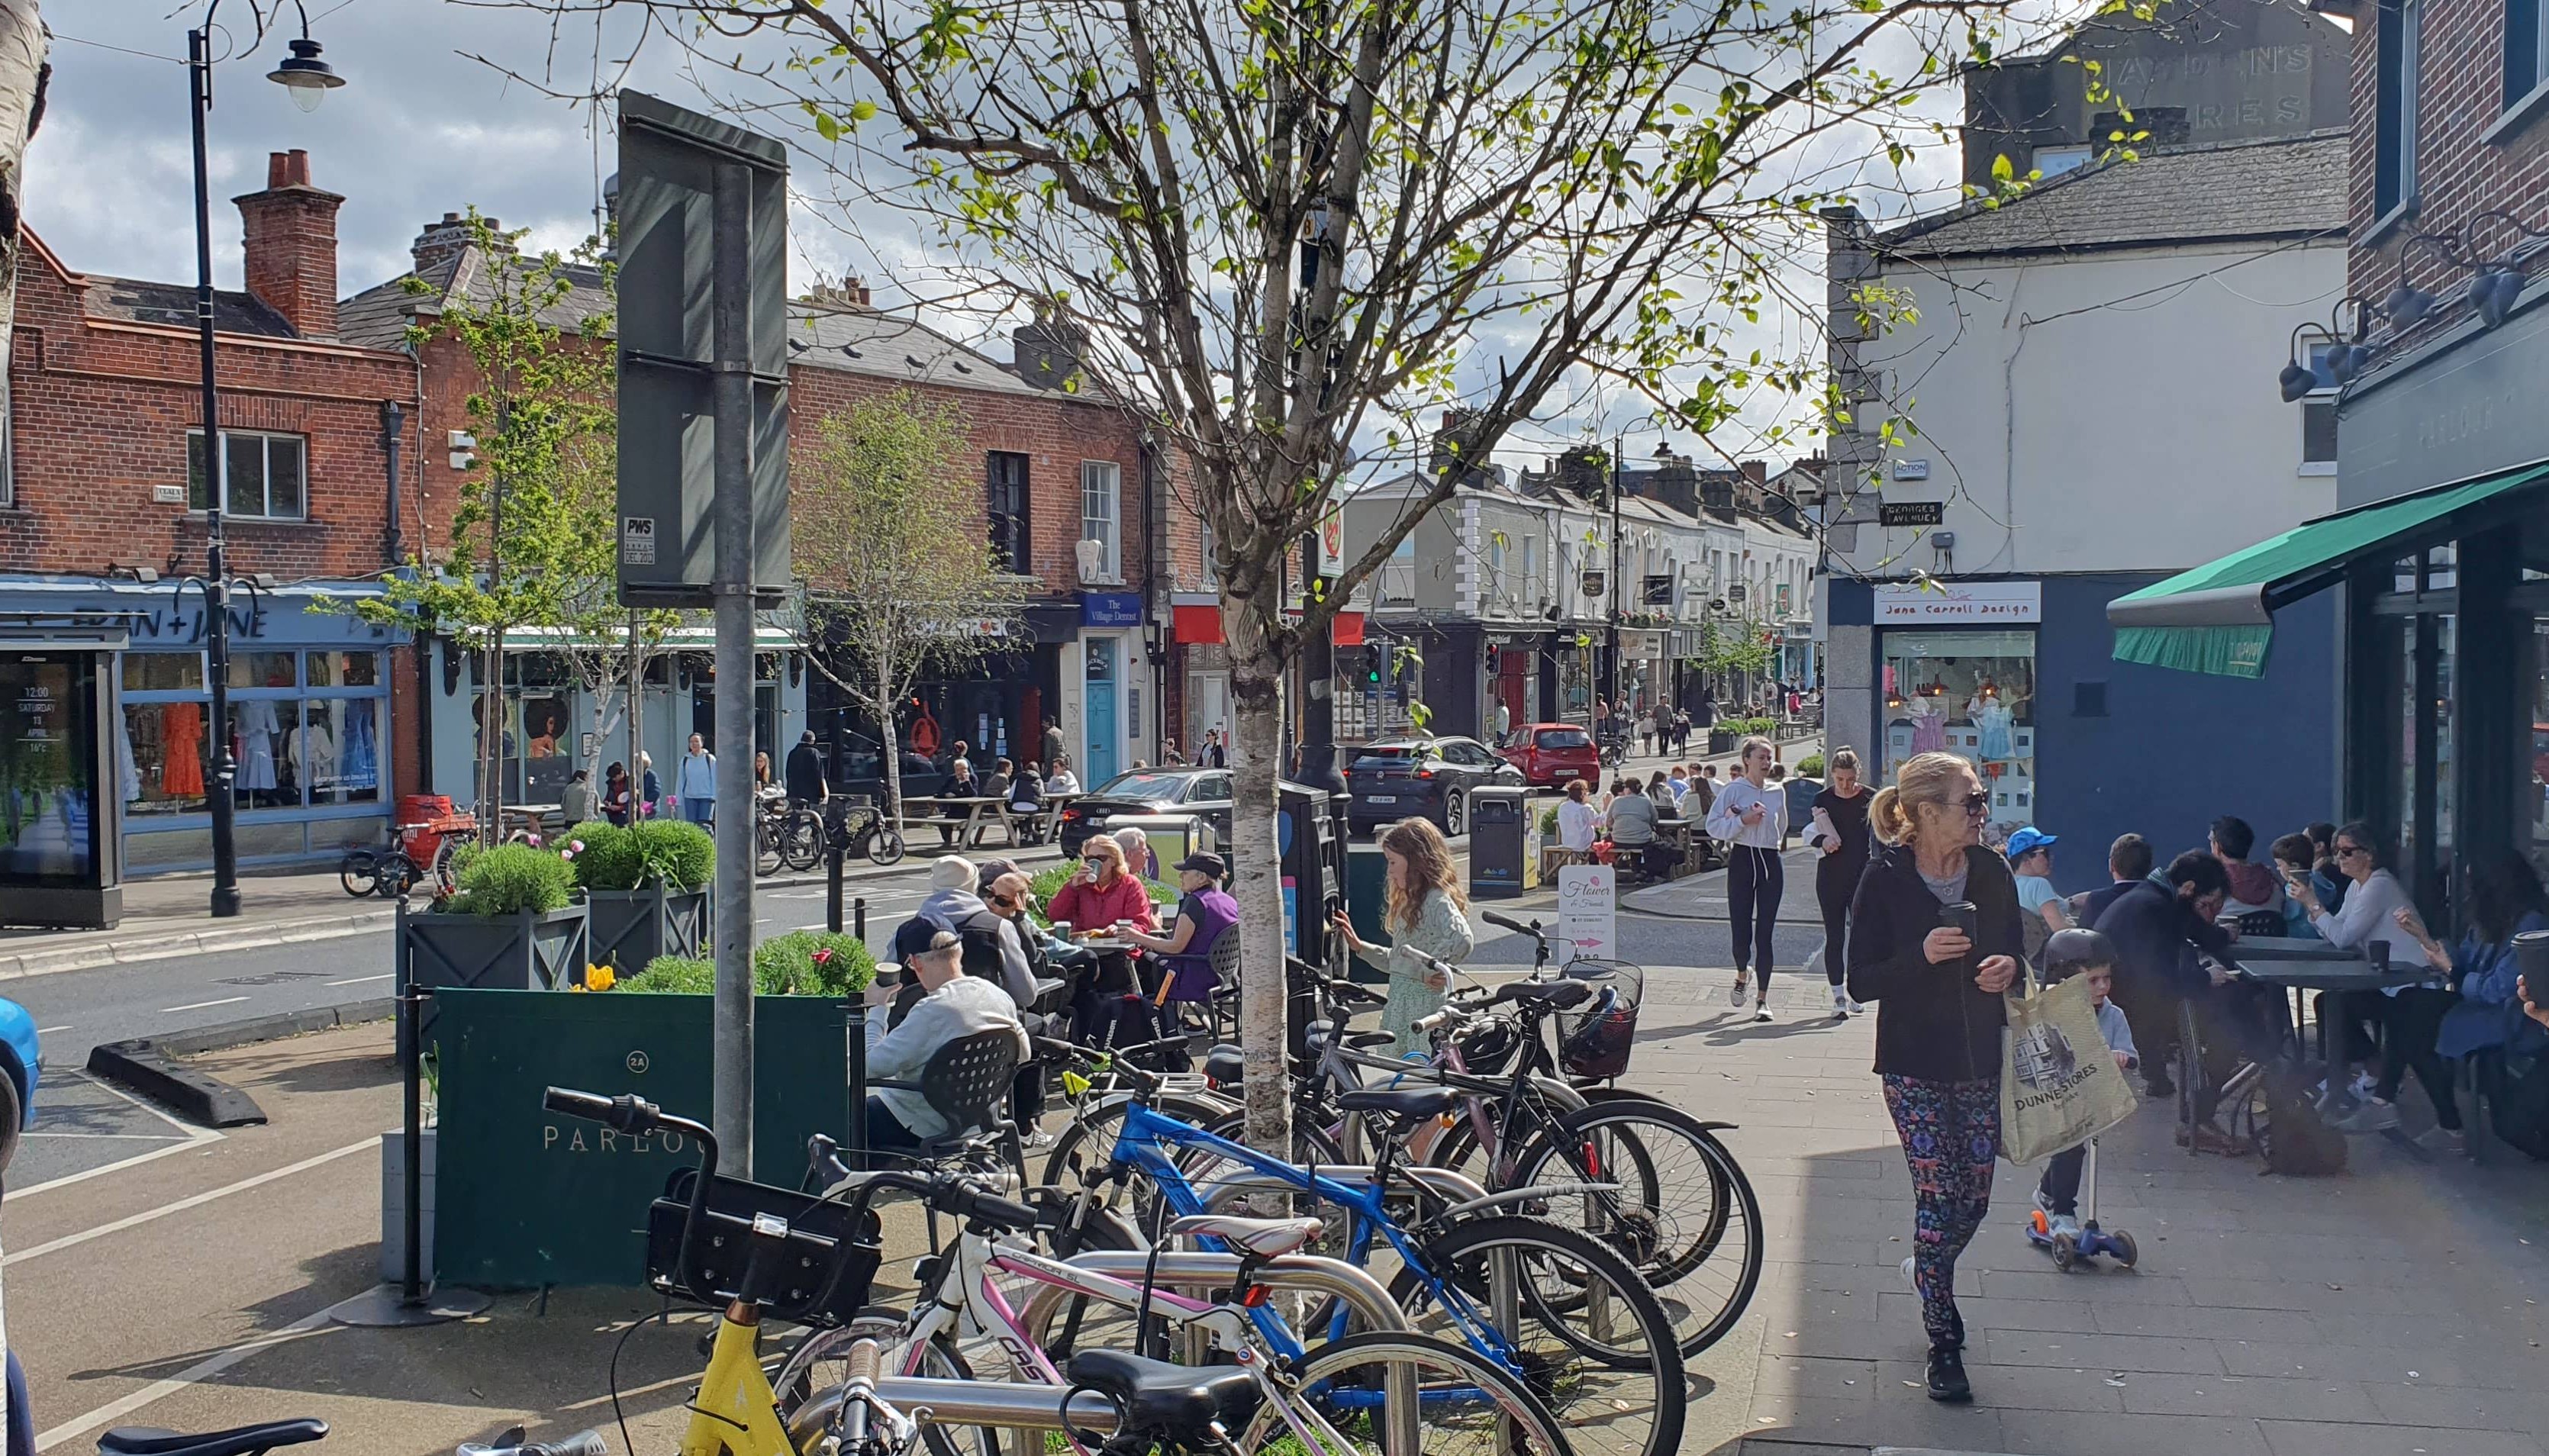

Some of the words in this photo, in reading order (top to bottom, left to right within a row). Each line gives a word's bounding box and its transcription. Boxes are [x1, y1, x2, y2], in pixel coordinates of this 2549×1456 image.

[627, 520, 652, 534] PWS
[1107, 600, 1121, 609] The
[1886, 605, 1916, 615] Jane
[1925, 604, 1973, 614] Carroll
[1980, 604, 2029, 617] Design
[1091, 610, 1113, 623] Village
[1114, 611, 1137, 620] Dentist
[187, 610, 269, 643] JNE
[24, 687, 50, 697] 12:00
[18, 703, 56, 714] SATURDAY
[1563, 881, 1610, 897] Flower
[630, 1058, 645, 1068] 2A
[2014, 1089, 2062, 1111] DUNNE
[2060, 1063, 2098, 1093] STORES
[544, 1126, 705, 1154] PARLO
